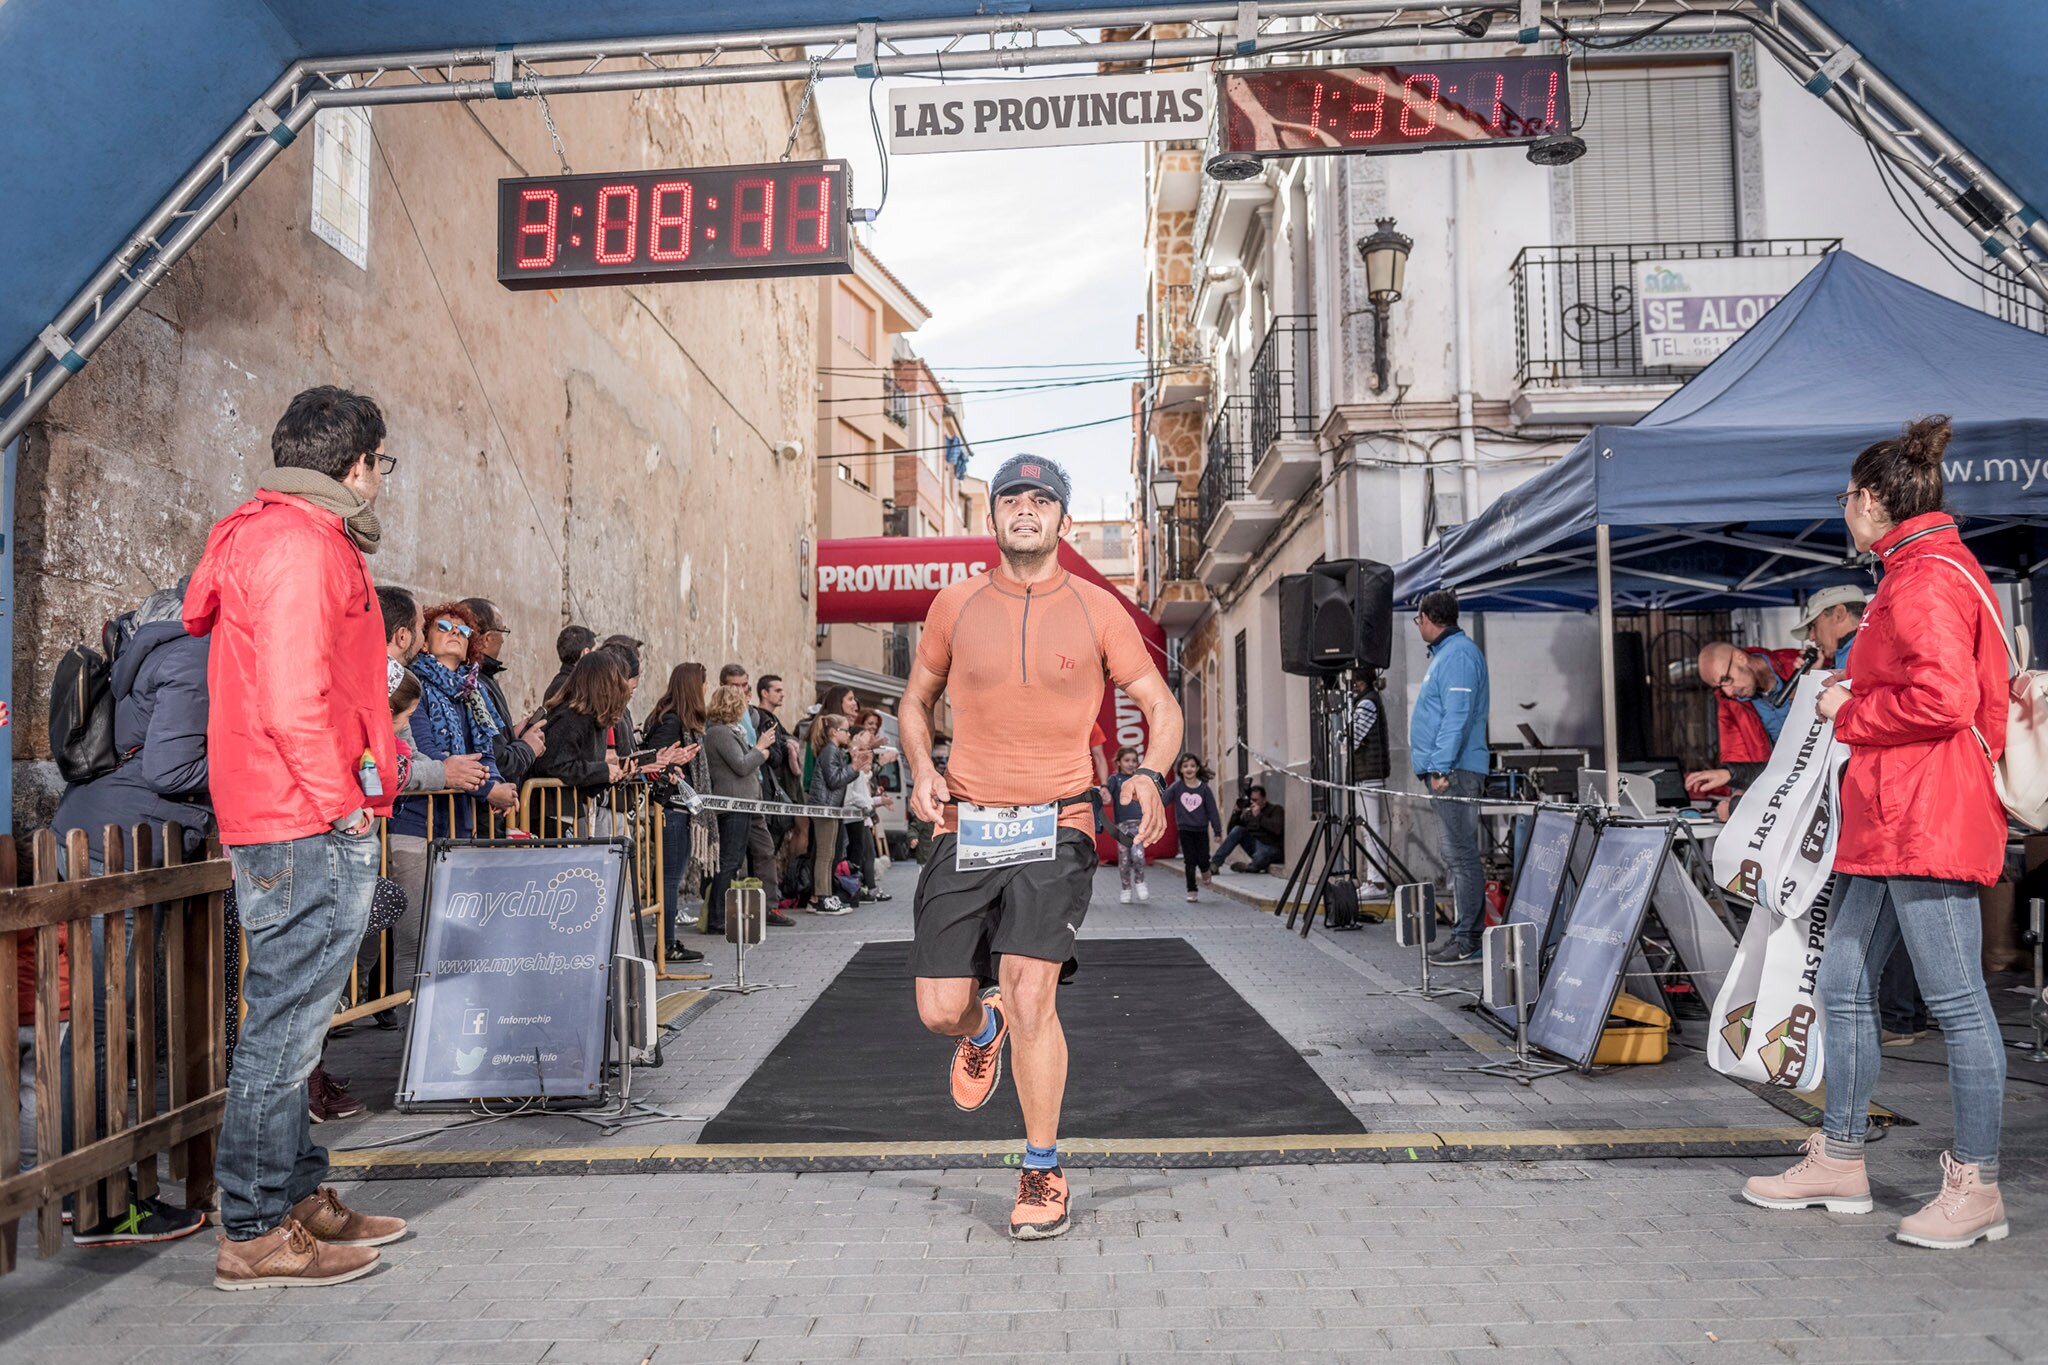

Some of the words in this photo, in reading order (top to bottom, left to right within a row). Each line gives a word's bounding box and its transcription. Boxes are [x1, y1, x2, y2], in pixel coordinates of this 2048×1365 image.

[894, 101, 965, 138] LAS
[973, 88, 1204, 133] PROVINCIAS
[516, 175, 831, 268] 3:08:11
[1648, 300, 1685, 331] SE
[980, 819, 1035, 841] 1084
[1747, 811, 1778, 852] LAS
[445, 880, 578, 927] mychip
[436, 952, 596, 977] www.mychip.es
[1798, 953, 1822, 996] LAS
[497, 1014, 552, 1026] /infomychip
